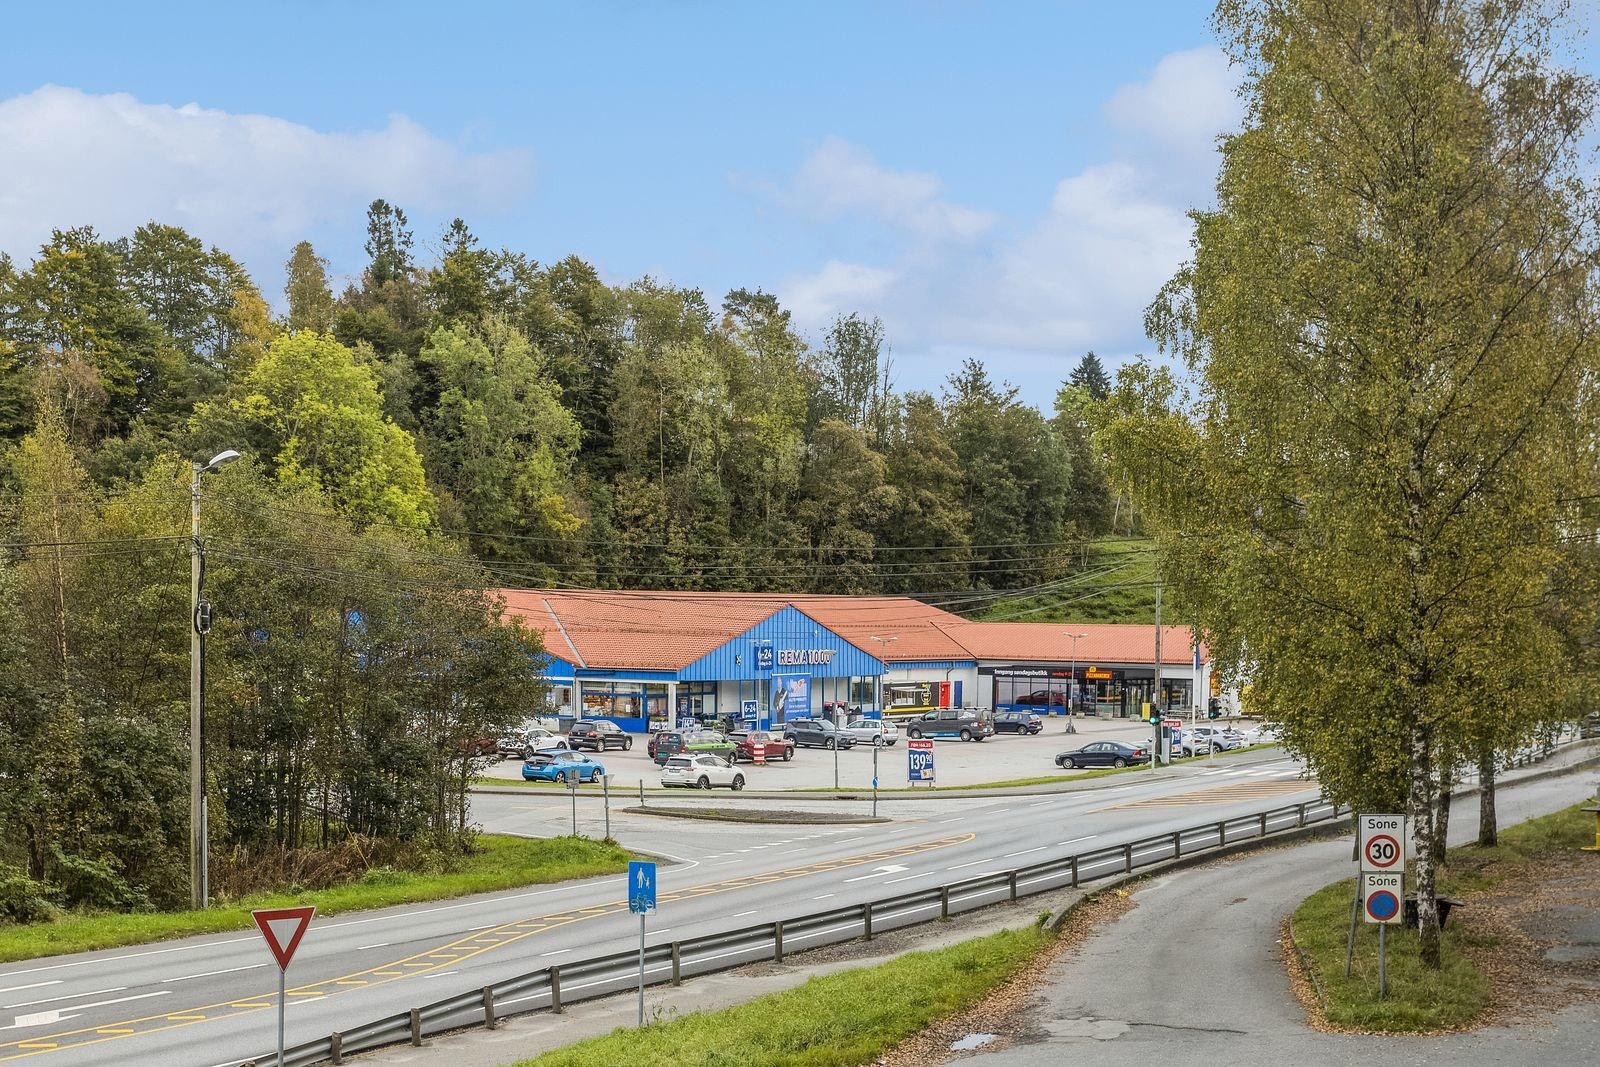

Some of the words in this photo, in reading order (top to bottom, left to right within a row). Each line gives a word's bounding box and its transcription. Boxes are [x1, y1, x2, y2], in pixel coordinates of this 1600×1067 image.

[778, 649, 808, 665] REMA
[909, 753, 926, 770] 139
[1368, 819, 1397, 829] Sone
[1372, 843, 1394, 860] 30
[1368, 876, 1398, 886] Sone
